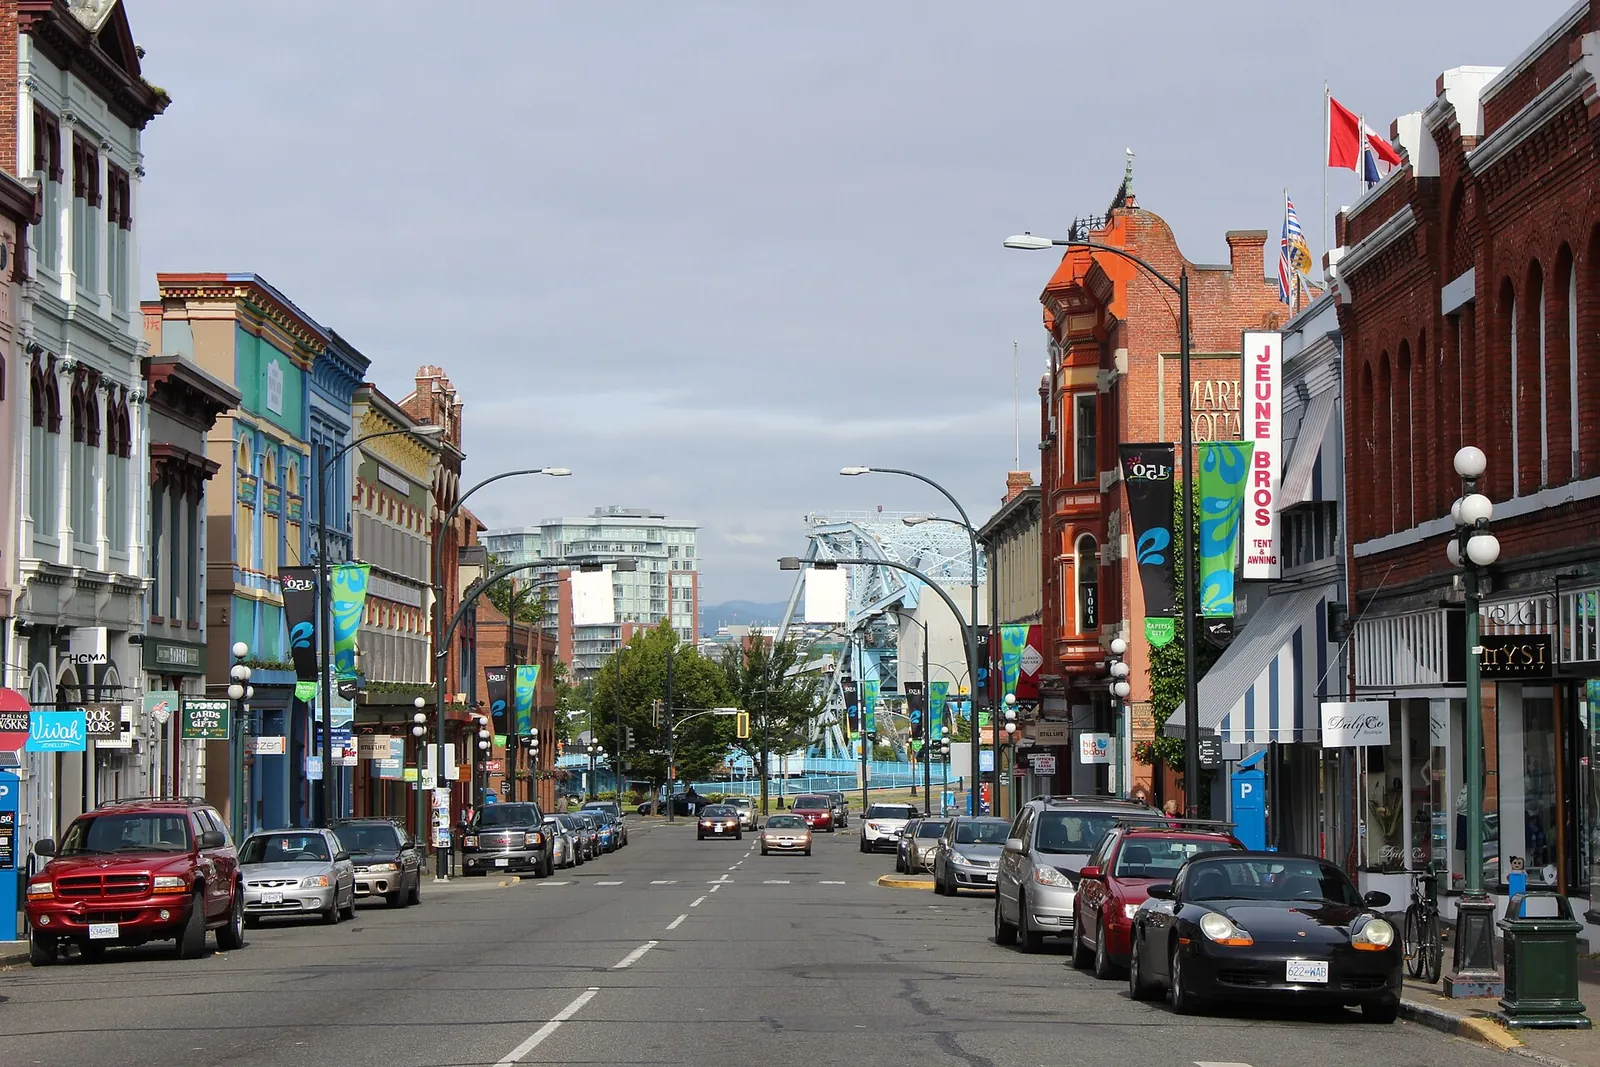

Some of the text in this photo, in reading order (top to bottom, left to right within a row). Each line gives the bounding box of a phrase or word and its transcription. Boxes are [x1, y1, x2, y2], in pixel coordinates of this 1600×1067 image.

[1190, 412, 1241, 442] QUA
[1254, 345, 1272, 526] JEUNE BROS
[1252, 539, 1272, 548] TENT
[1247, 556, 1277, 564] AWNING
[69, 653, 106, 664] HCMA
[190, 710, 221, 719] CARDS
[1082, 740, 1096, 748] hip
[1083, 748, 1106, 757] baby
[1241, 783, 1252, 799] P
